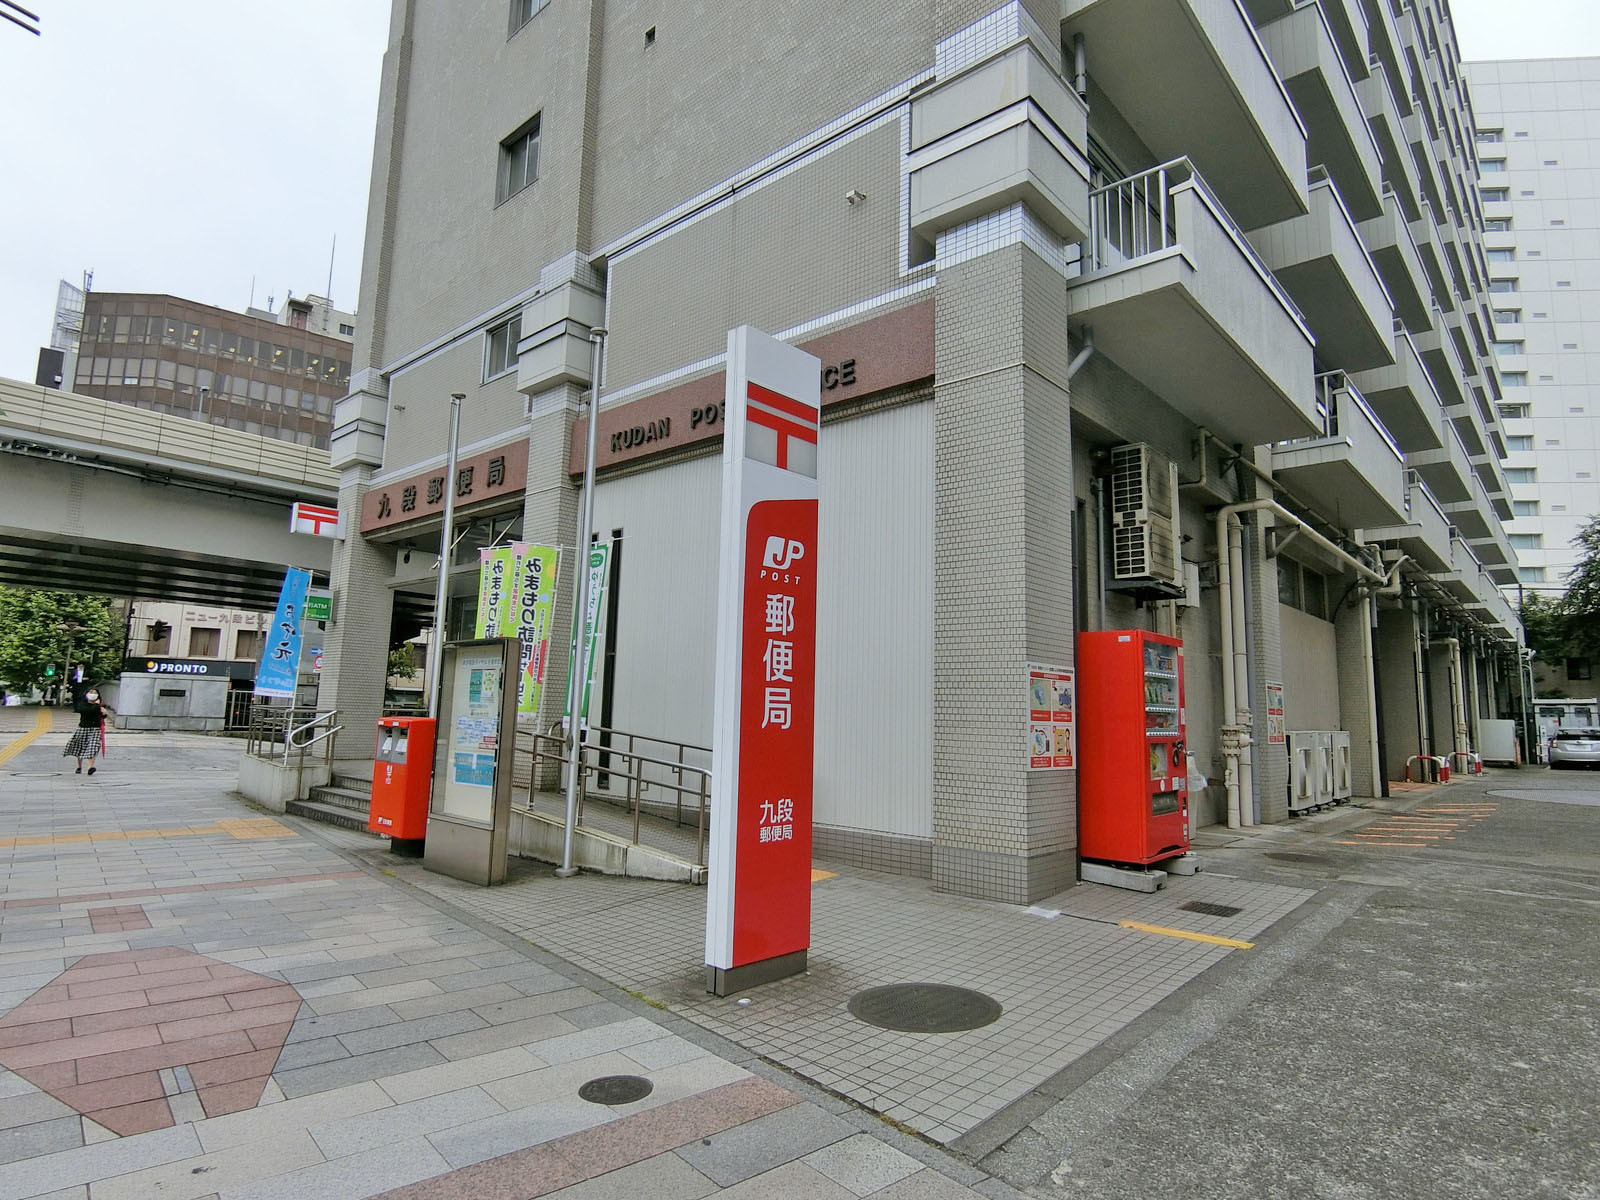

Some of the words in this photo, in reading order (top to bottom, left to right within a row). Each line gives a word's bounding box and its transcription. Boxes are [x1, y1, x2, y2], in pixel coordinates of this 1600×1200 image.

[610, 417, 671, 452] KUDAN
[378, 456, 505, 519] 九段郵便局
[760, 569, 801, 585] POST
[160, 663, 208, 674] PRONTO
[761, 593, 796, 730] 郵便局
[759, 798, 794, 825] 九段
[759, 824, 793, 843] 郵便局
